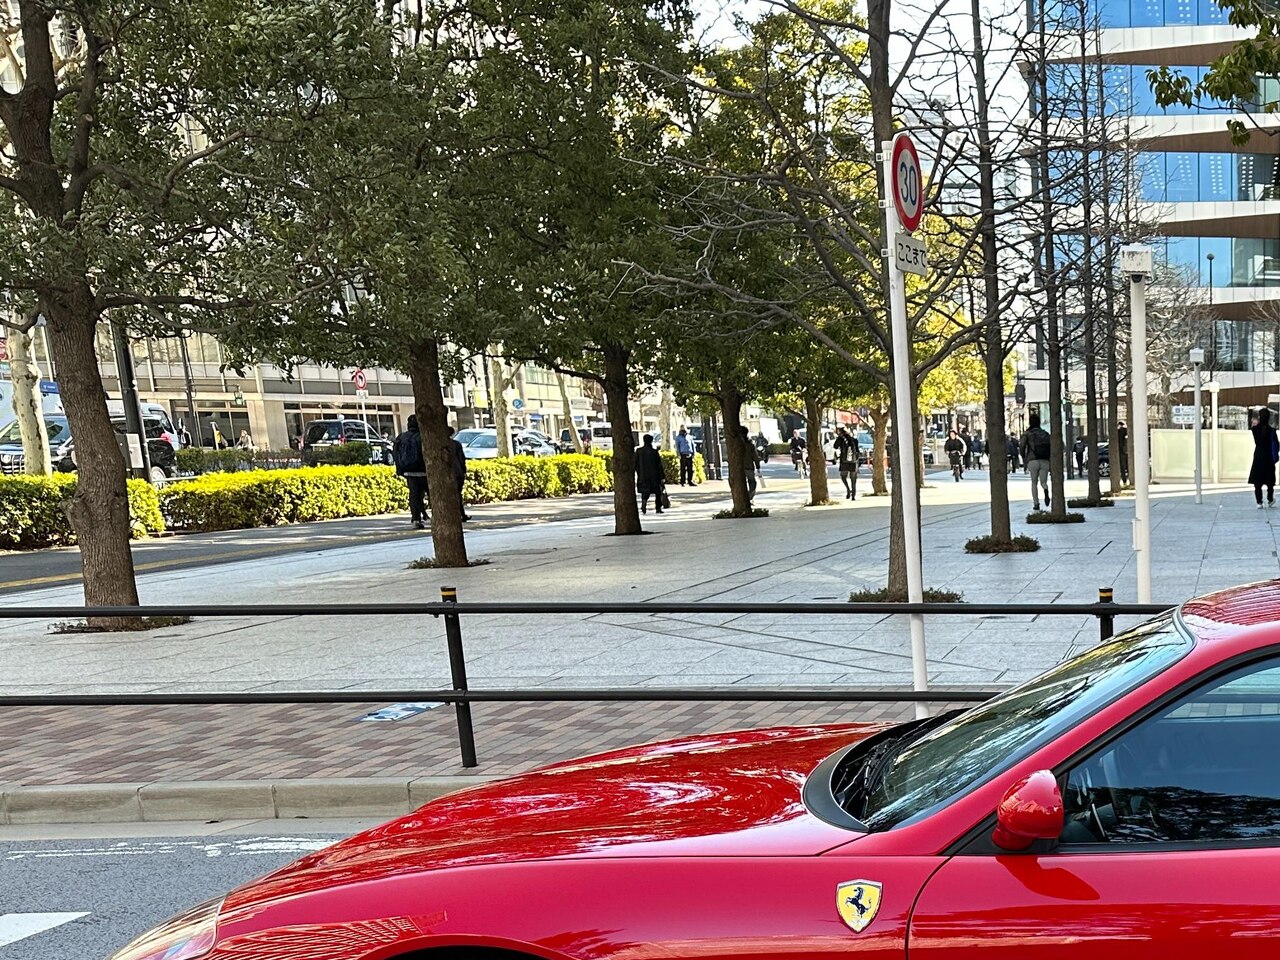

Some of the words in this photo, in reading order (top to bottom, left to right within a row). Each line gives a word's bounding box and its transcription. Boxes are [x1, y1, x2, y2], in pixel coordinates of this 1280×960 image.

[900, 162, 917, 206] 30
[898, 242, 927, 268] ここまで
